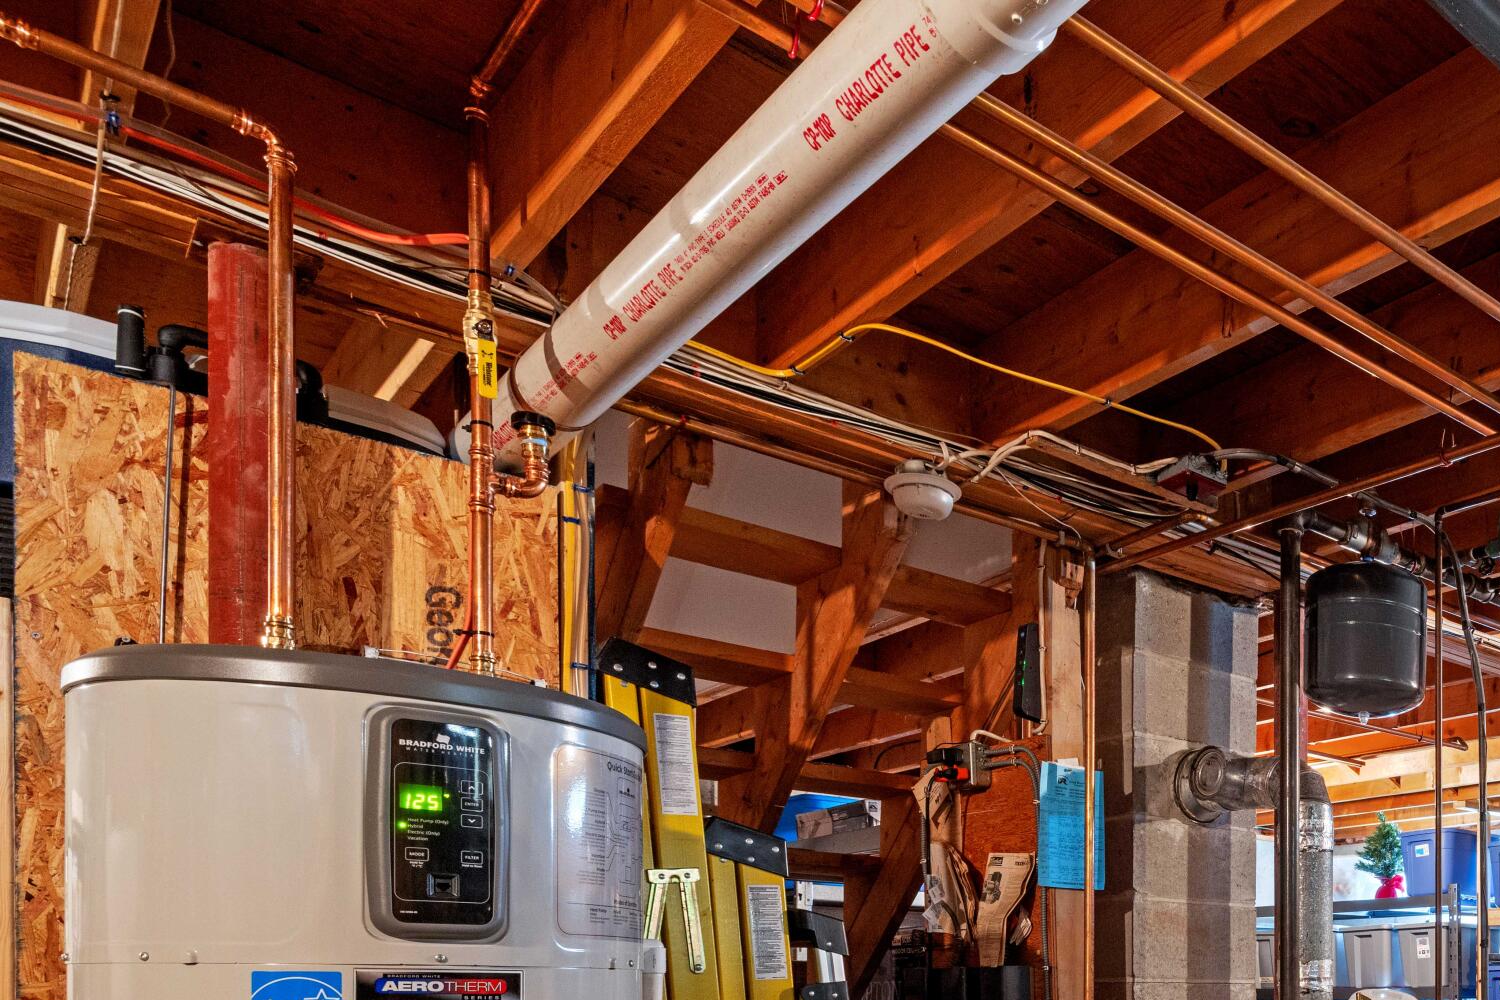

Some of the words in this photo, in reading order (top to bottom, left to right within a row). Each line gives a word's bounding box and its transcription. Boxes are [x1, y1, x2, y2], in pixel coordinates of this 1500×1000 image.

[835, 53, 902, 122] CHARLOTTE
[893, 24, 930, 67] PIPE
[622, 279, 667, 323] CHARLOTTE
[657, 263, 683, 290] PIPE
[399, 738, 453, 751] BRADFORD
[455, 745, 486, 755] WHITE
[405, 746, 435, 754] WATER
[607, 761, 623, 773] Quick
[404, 792, 440, 810] 125
[382, 980, 503, 992] AEROTHERM
